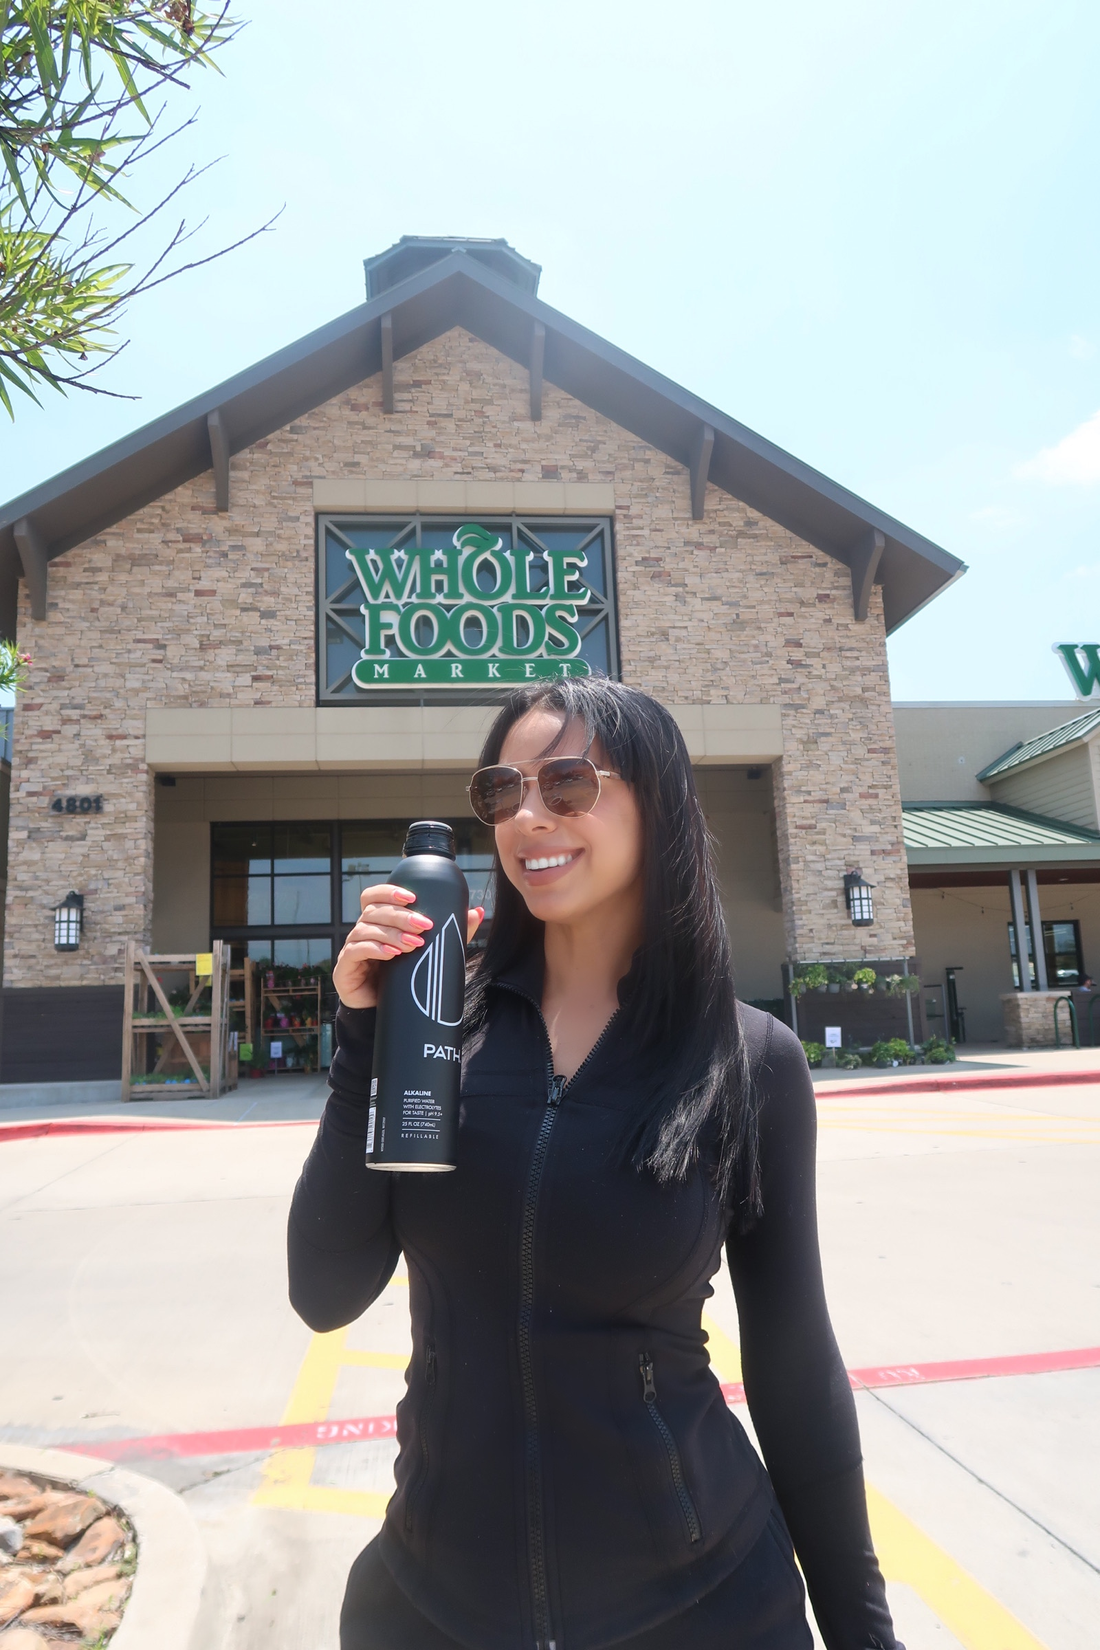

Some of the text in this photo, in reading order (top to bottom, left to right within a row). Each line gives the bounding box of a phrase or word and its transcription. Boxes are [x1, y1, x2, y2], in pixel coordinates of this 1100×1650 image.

[346, 548, 590, 604] WHOLE
[361, 603, 582, 658] FOODS
[373, 663, 572, 679] MARKET
[1051, 642, 1100, 701] W
[51, 795, 102, 813] 4801
[423, 1043, 461, 1064] PATH
